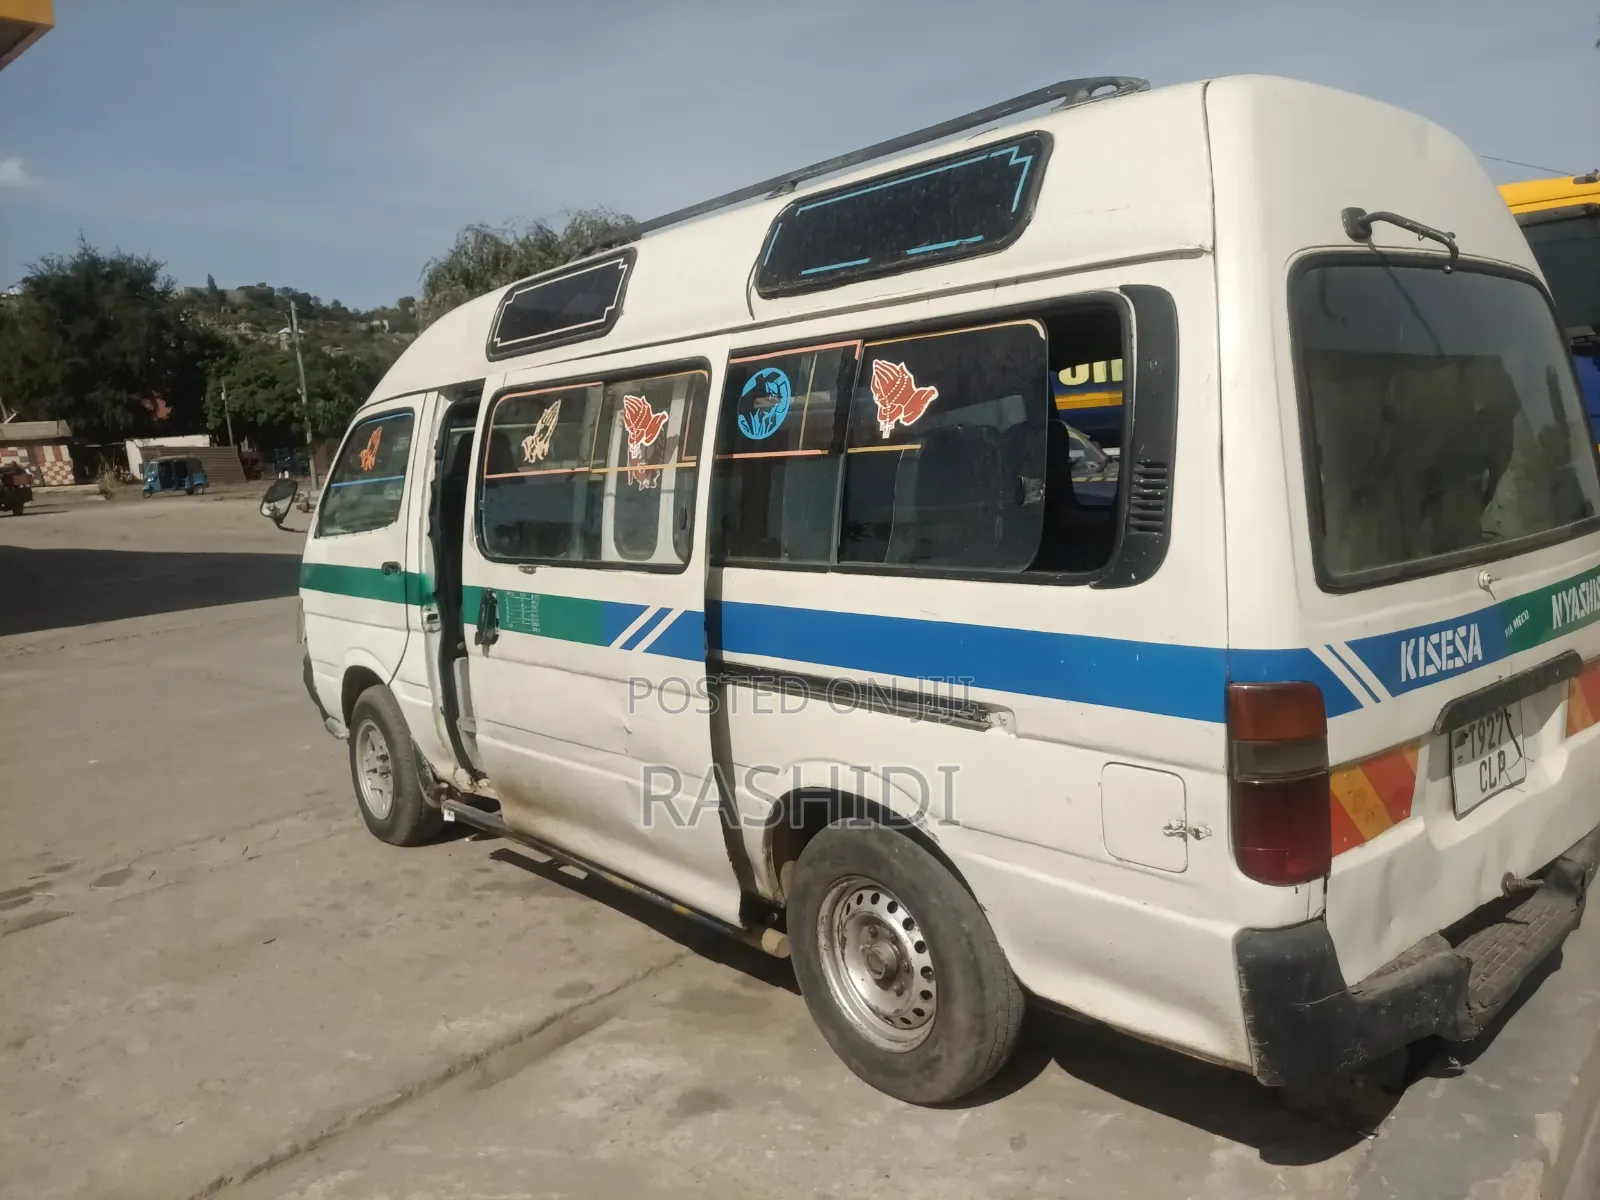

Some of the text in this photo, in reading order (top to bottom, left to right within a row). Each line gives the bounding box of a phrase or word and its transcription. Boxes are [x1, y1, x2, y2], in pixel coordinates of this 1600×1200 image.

[1513, 610, 1529, 630] MECO
[1401, 624, 1482, 682] KISESA
[1468, 709, 1504, 760] T927
